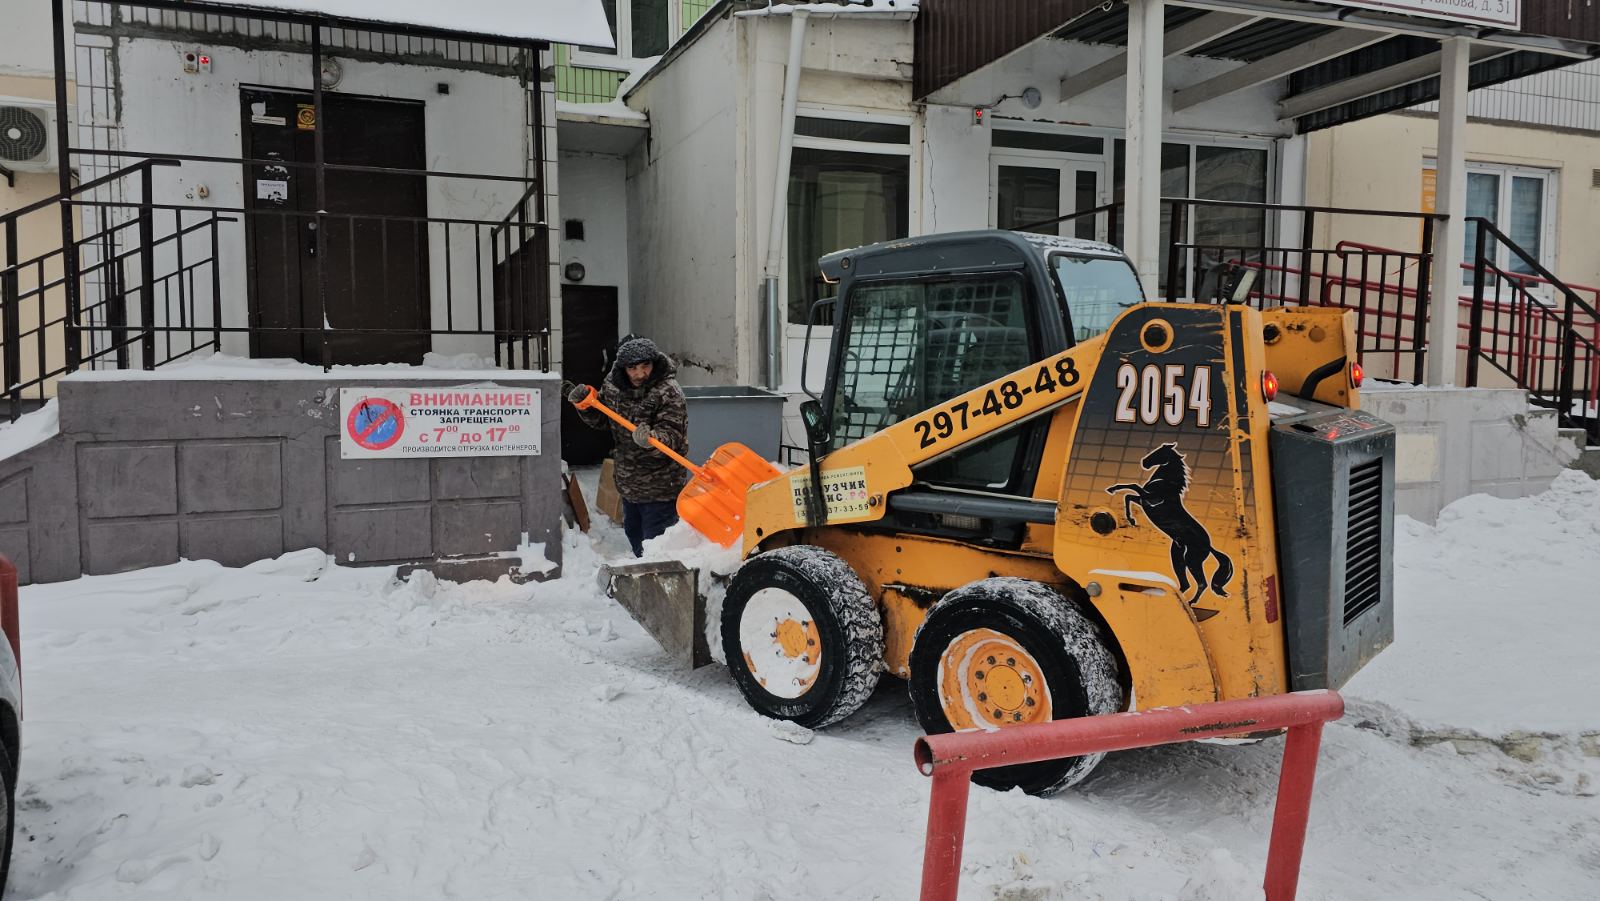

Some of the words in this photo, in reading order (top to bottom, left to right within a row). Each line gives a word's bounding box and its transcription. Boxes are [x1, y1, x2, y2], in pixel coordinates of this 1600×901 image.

[1496, 0, 1509, 14] 31
[409, 392, 532, 406] ВНИМАНИЕ!
[1115, 363, 1212, 428] 2054
[914, 357, 1080, 449] 297-48-48
[410, 408, 460, 416] СТОЯНКА
[463, 408, 530, 416] ТРАНСПОРТА
[439, 416, 503, 425] ЗАПРЕЩЕНА
[460, 433, 482, 444] до
[402, 445, 456, 453] ПРОИЗВОДИТСЯ
